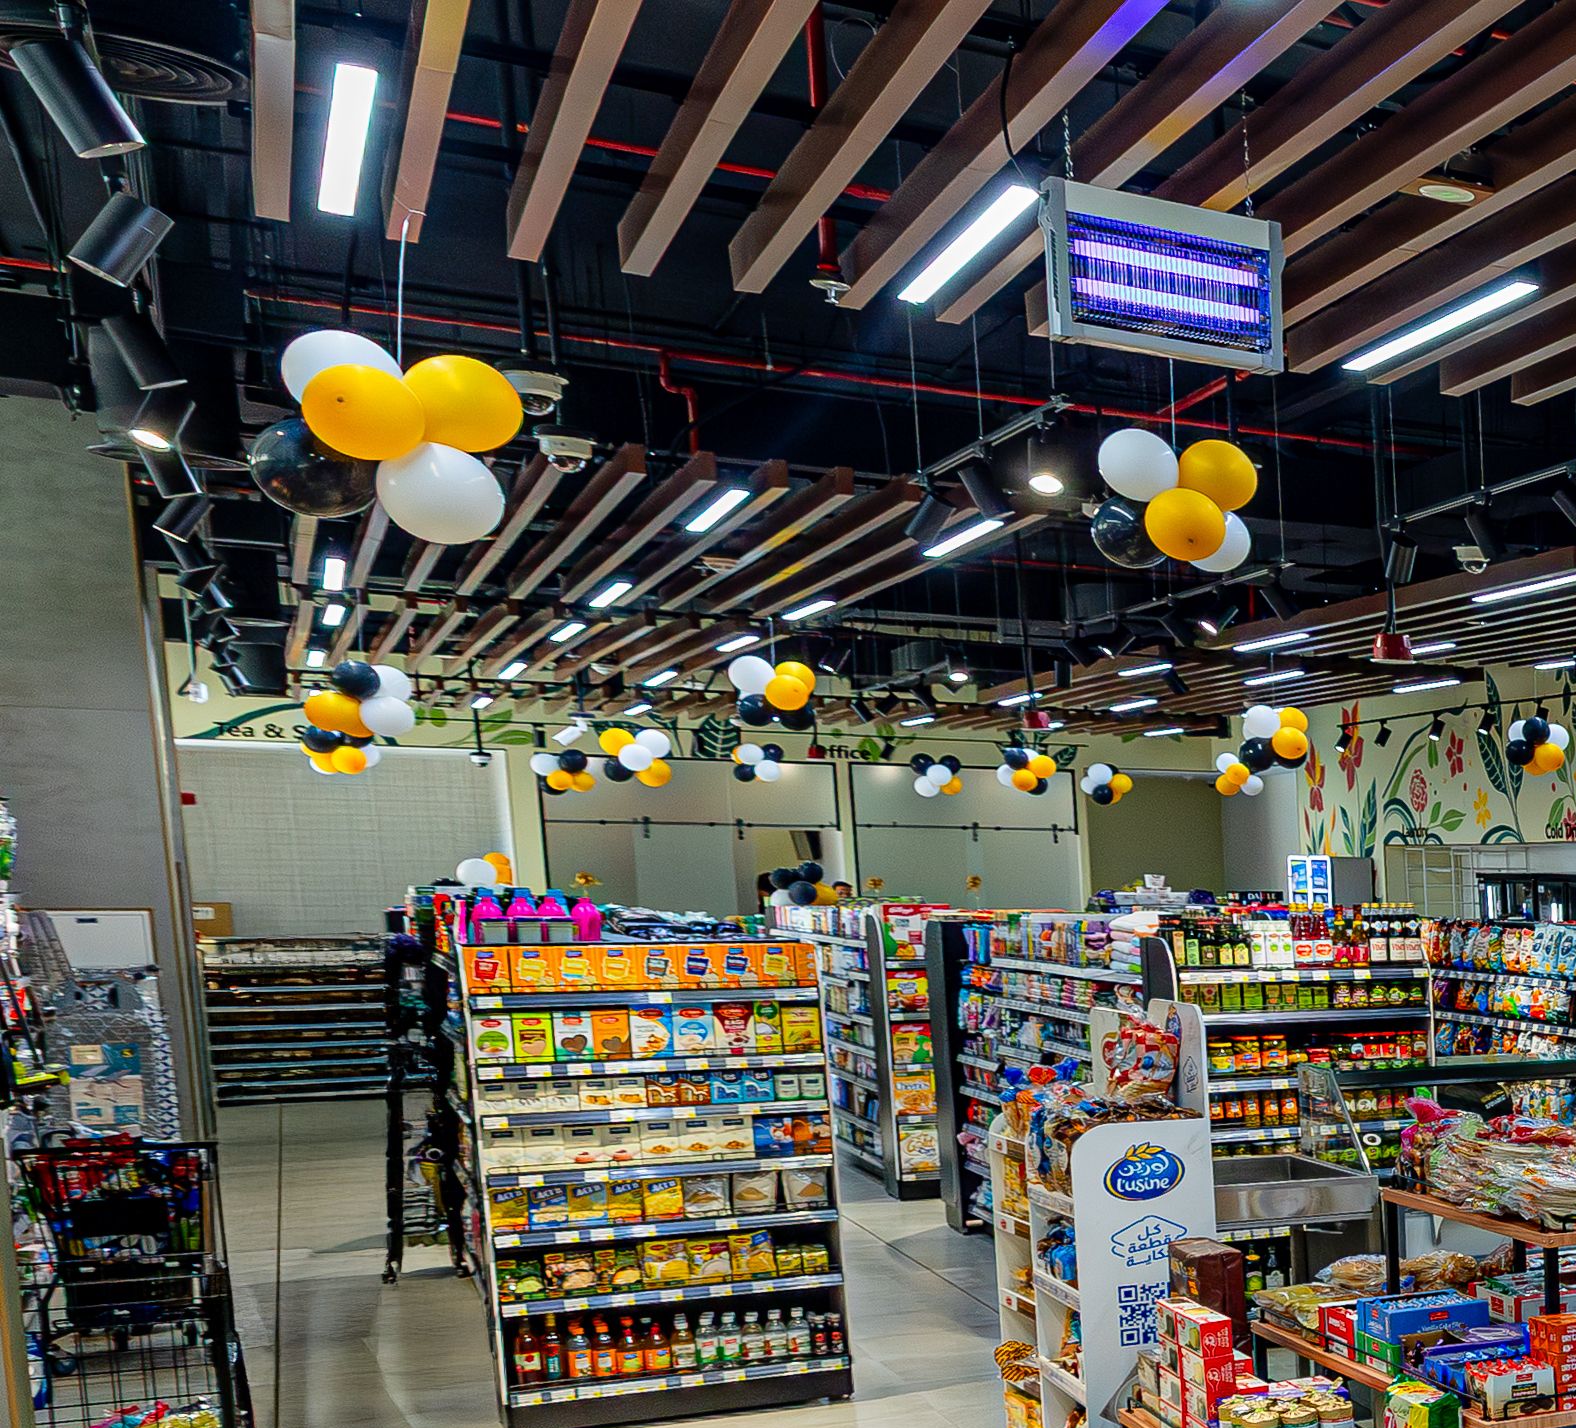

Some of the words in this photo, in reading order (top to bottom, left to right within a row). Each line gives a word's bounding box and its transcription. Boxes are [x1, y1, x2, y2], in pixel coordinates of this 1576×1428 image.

[213, 721, 255, 737] Tea
[264, 723, 285, 739] &
[1545, 823, 1563, 839] Cold
[1118, 1153, 1170, 1177] لوزين
[1138, 1224, 1162, 1241] كل
